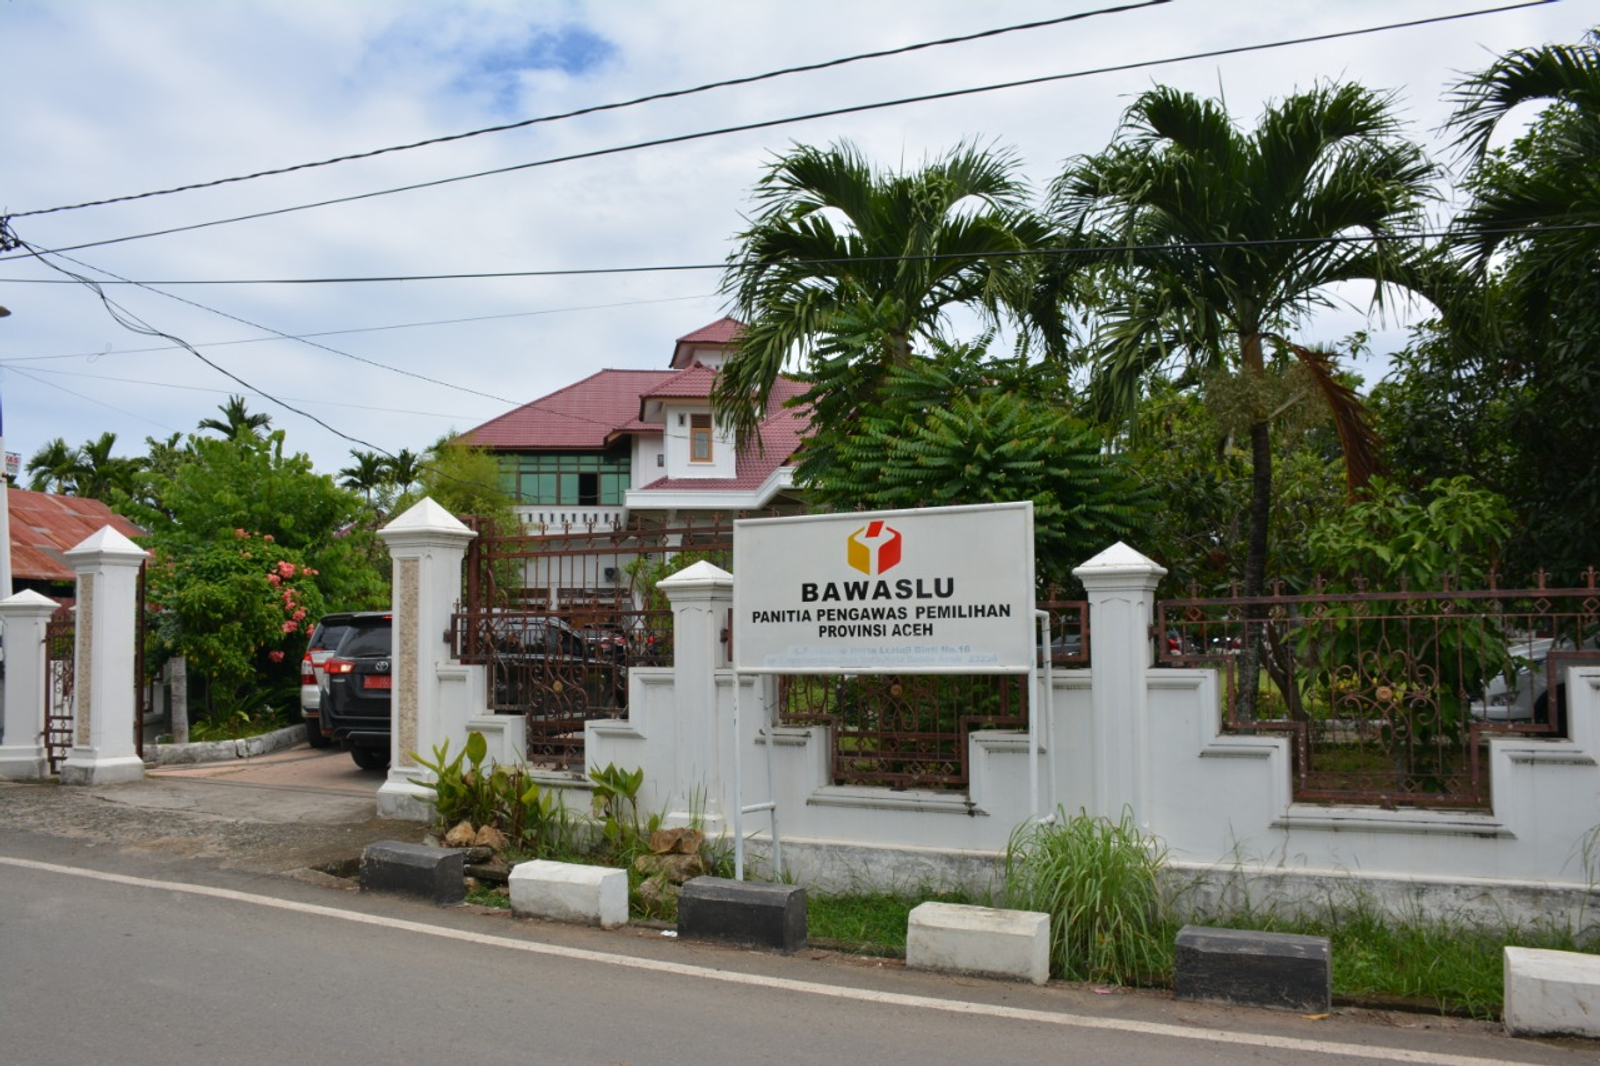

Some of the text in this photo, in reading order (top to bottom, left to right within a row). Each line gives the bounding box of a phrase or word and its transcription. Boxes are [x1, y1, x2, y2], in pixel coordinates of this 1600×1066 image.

[801, 577, 954, 603] BAWASLU
[752, 604, 1011, 624] PANITIA PENGAWAS PEMILIHAN
[818, 623, 934, 638] PROVINSI ACEH
